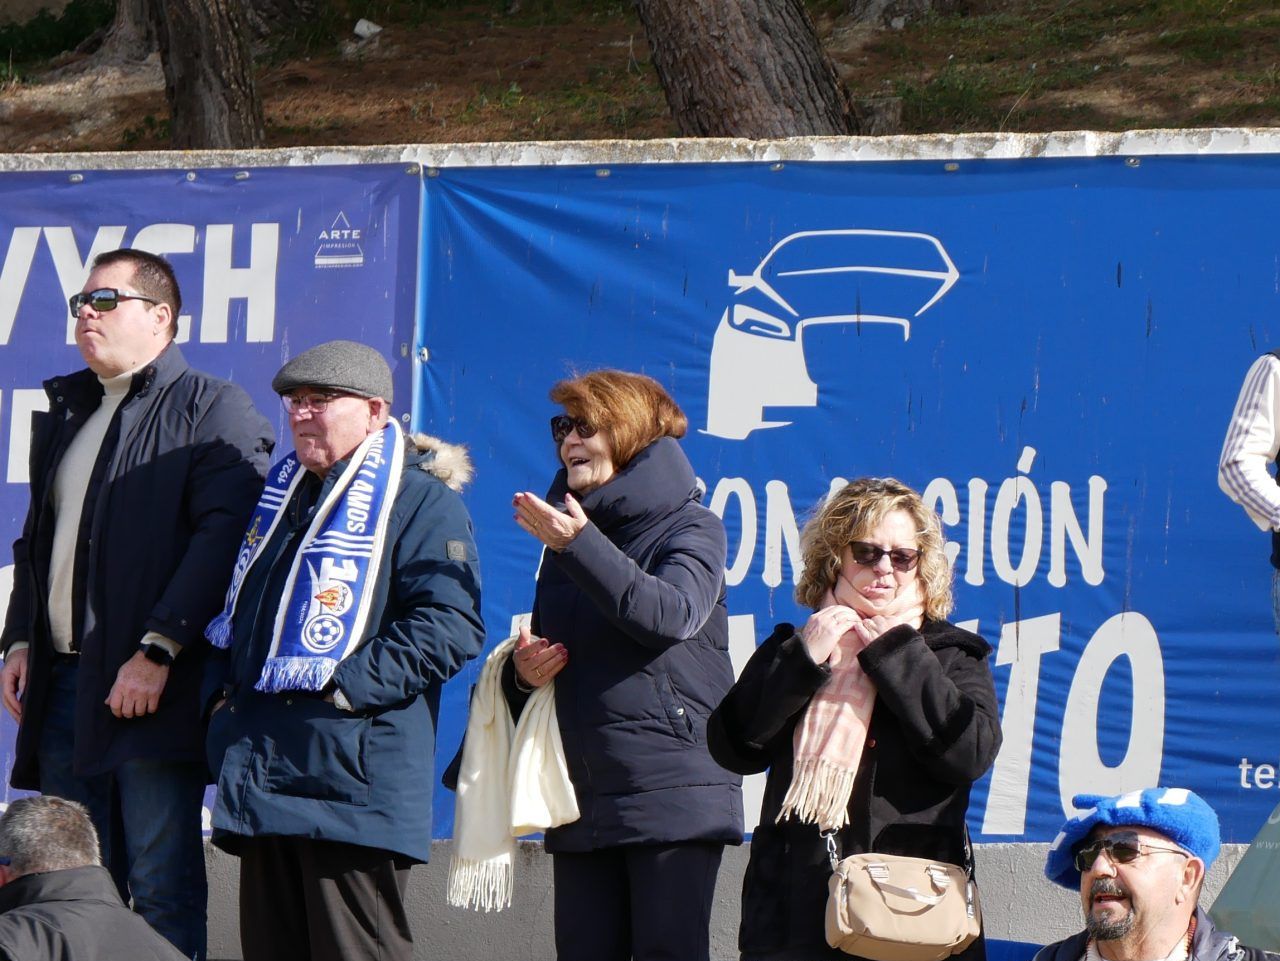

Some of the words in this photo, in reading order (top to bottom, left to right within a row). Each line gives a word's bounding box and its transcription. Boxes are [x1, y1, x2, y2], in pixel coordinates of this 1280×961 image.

[319, 230, 361, 240] ARTE
[277, 458, 296, 484] 1924
[1238, 757, 1280, 789] te
